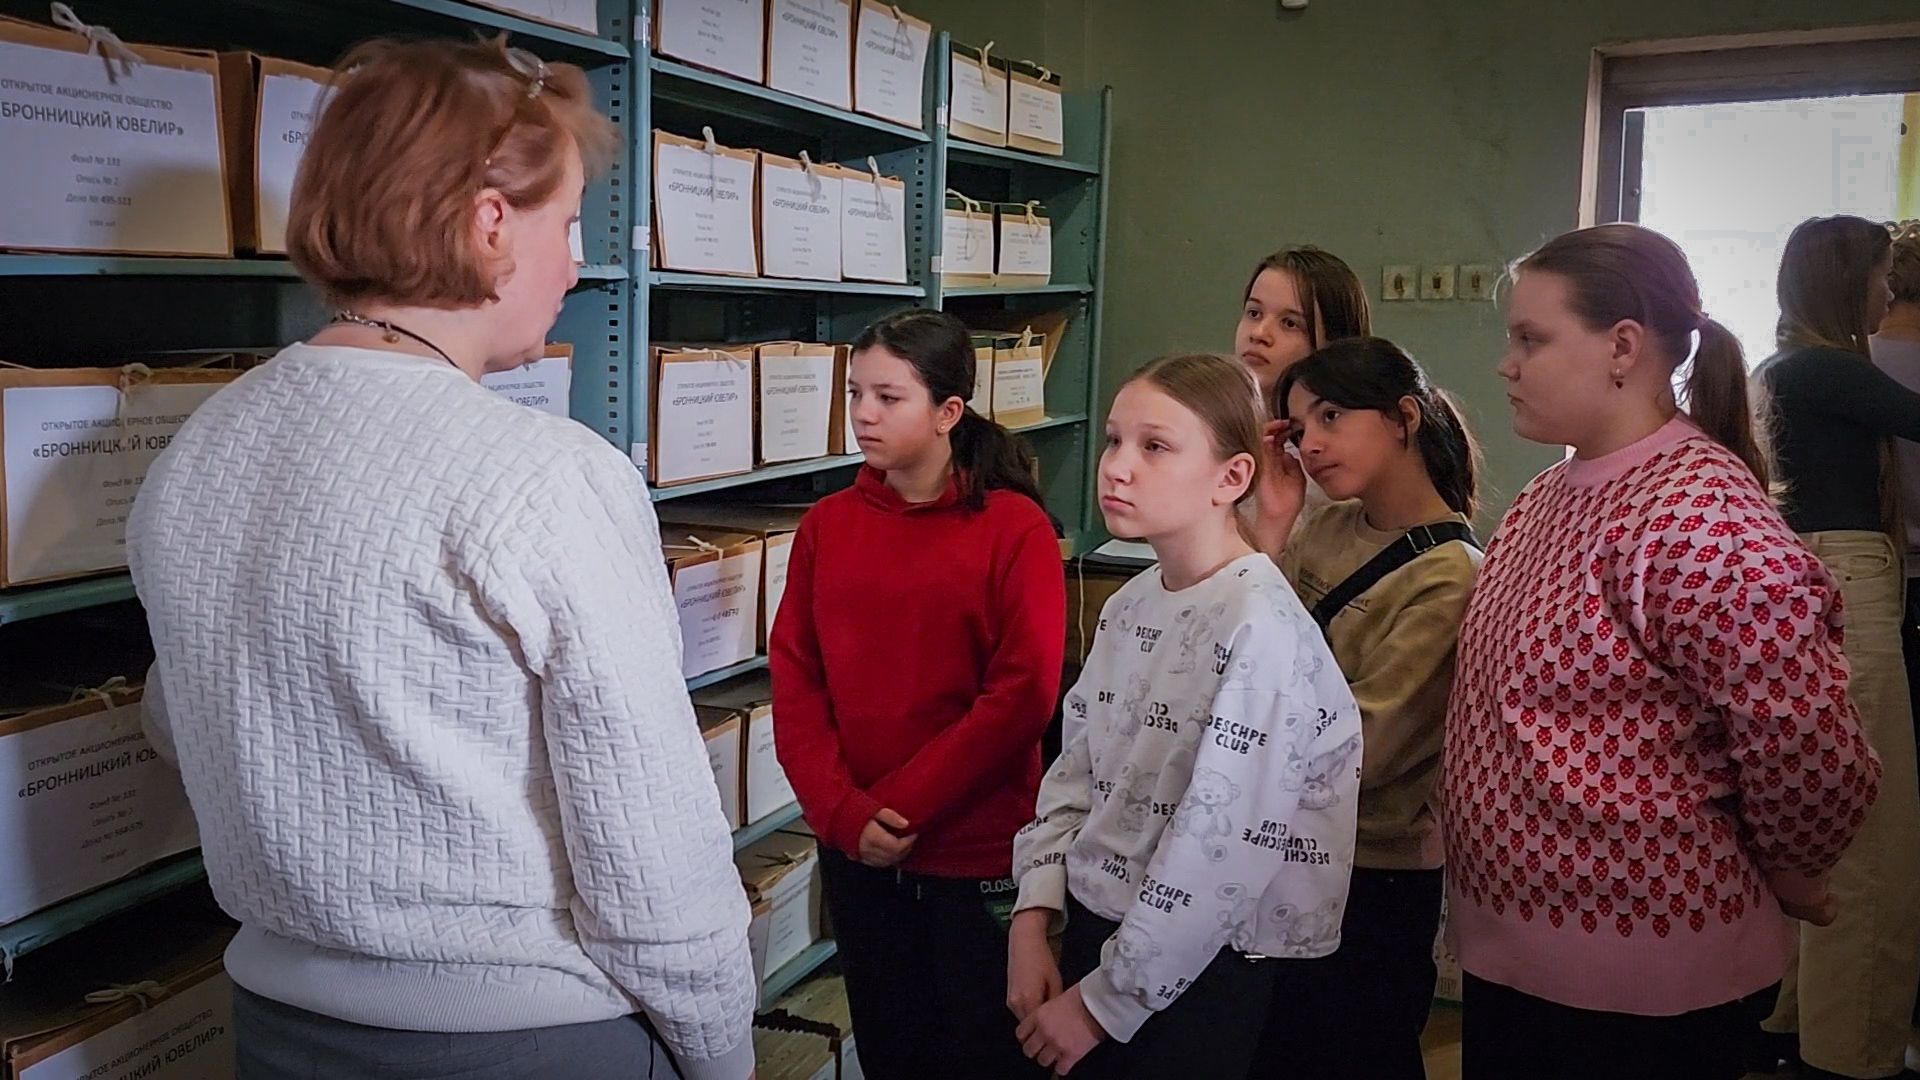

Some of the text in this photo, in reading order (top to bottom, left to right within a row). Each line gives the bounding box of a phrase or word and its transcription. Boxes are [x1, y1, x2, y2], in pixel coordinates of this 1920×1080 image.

[1, 79, 173, 111] ОТКРЫТОЕ АКЦИОНЕРНОЕ ОБЩЕСТВО
[116, 114, 185, 136] ЮВЕЛИР»
[41, 418, 88, 431] ОТКРЫТОЕ
[1207, 714, 1268, 747] DESCHPE
[1215, 733, 1249, 754] CLUB
[28, 748, 78, 771] ОТКРЫТОЕ
[18, 751, 131, 798] «БРОННИЦКИЙ
[1260, 820, 1287, 837] CLUB
[1139, 890, 1174, 914] CLUB
[164, 1026, 225, 1064] ЮВЕЛИР»
